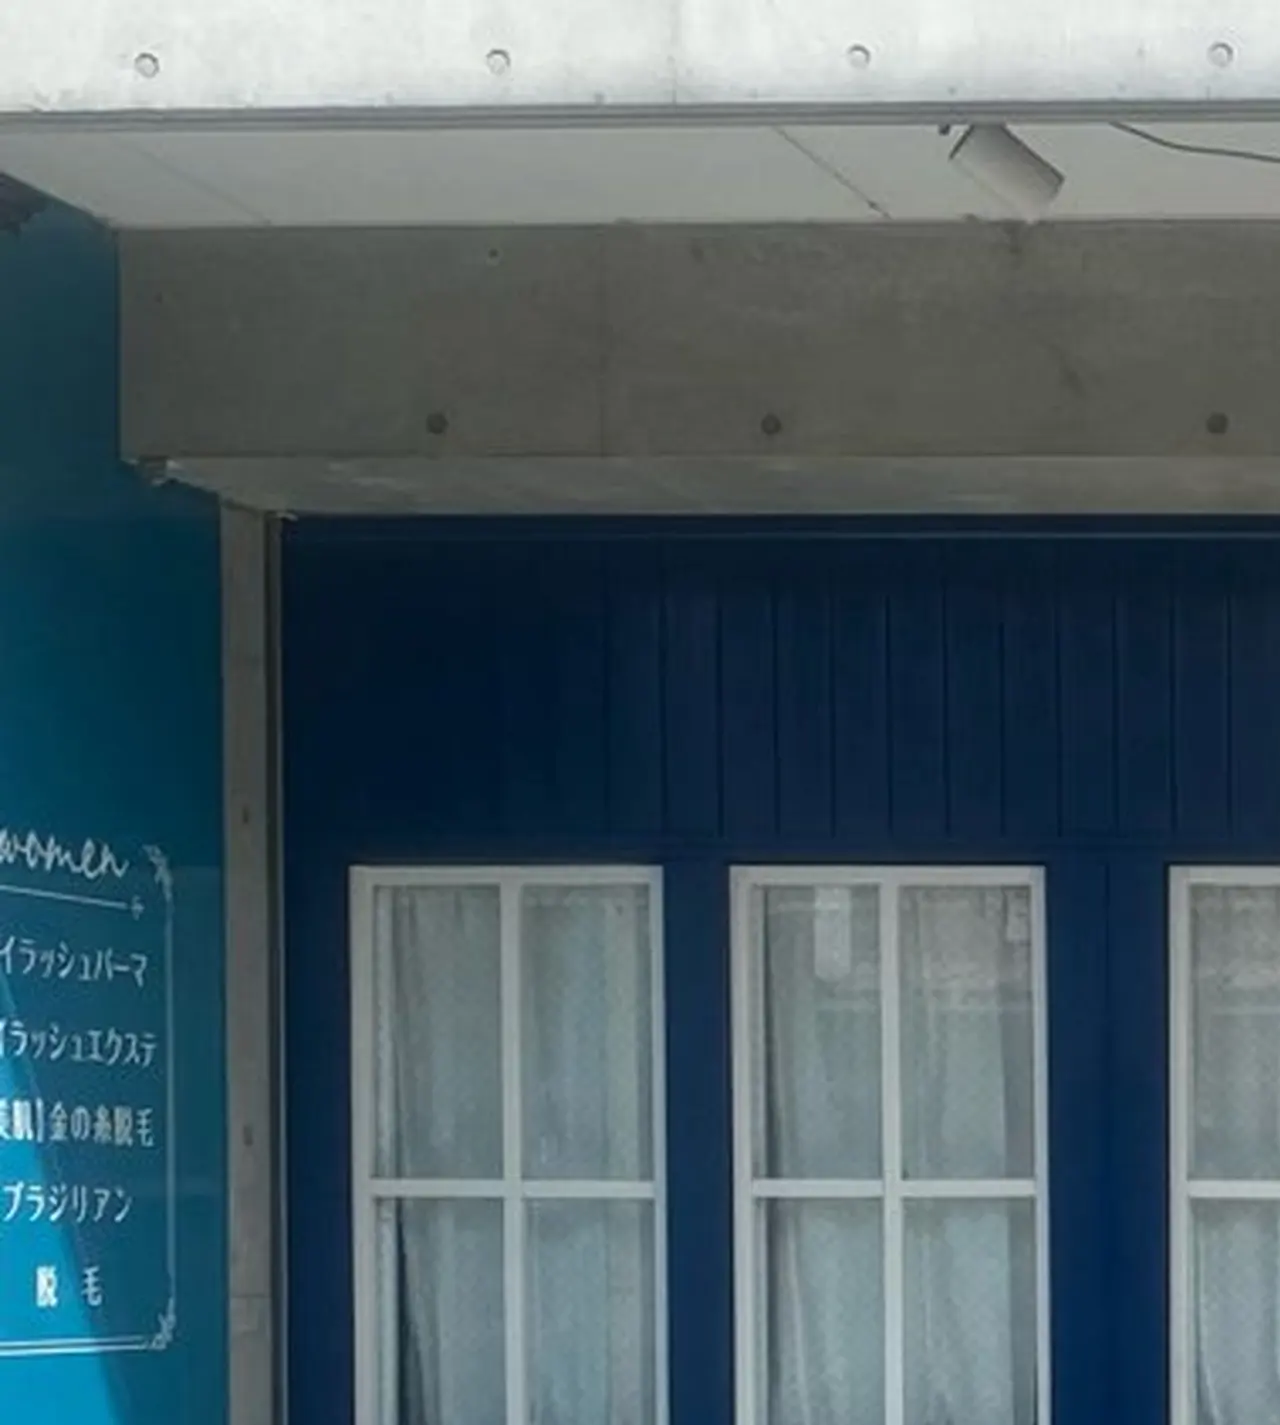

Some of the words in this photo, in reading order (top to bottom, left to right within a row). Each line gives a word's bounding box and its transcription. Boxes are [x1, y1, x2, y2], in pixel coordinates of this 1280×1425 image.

[2, 1180, 134, 1223] ブラジリアン
